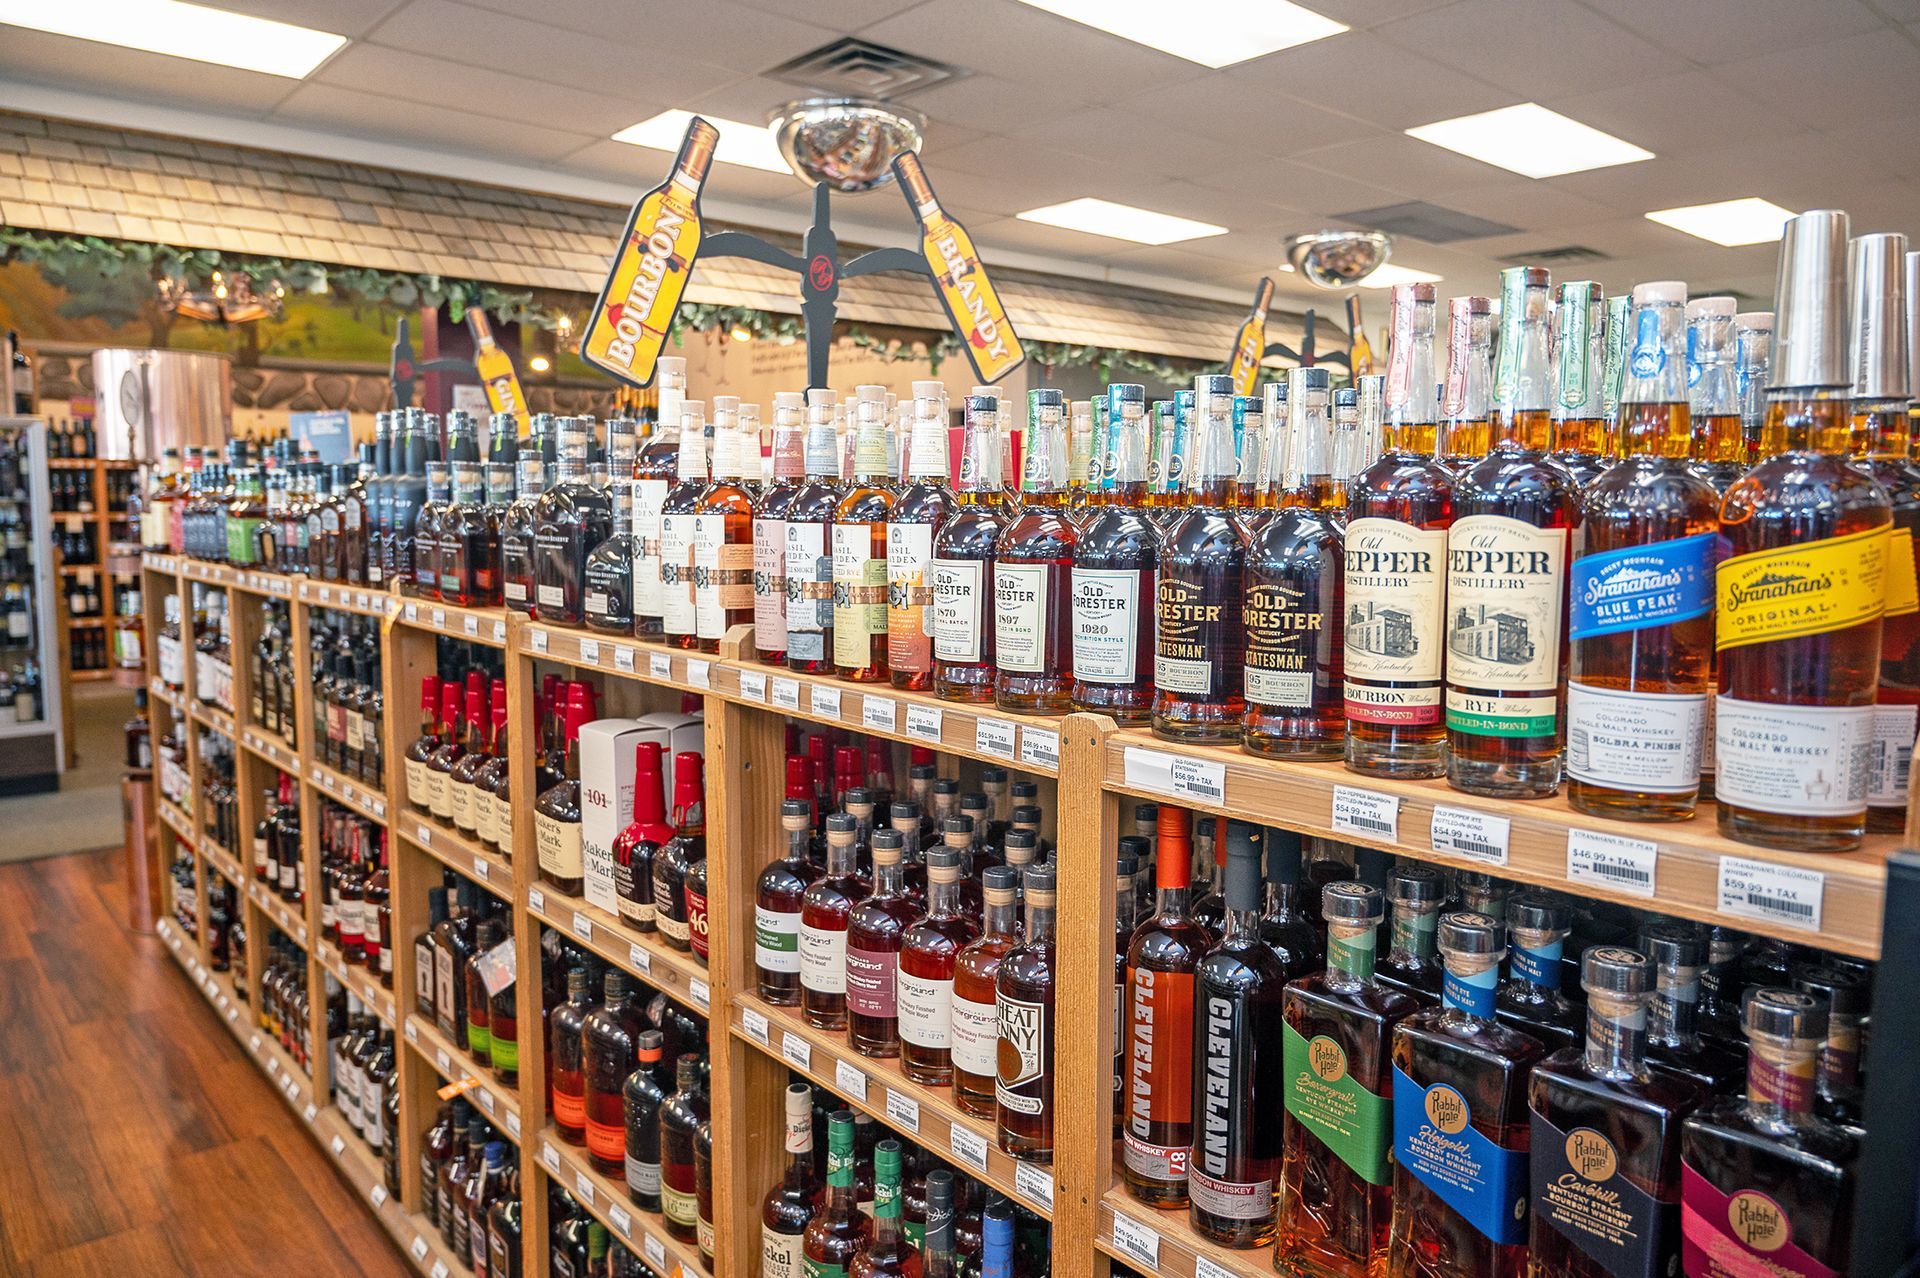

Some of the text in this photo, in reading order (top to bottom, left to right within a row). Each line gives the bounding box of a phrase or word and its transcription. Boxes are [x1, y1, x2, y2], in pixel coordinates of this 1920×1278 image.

[606, 206, 685, 369] BOURBON
[937, 235, 1009, 361] BRANDY
[1360, 536, 1384, 549] Old
[1471, 535, 1498, 548] Old
[1345, 550, 1433, 573] EPPER
[937, 574, 952, 584] OLD
[999, 578, 1015, 589] OLD
[1347, 576, 1409, 587] DISTILLERY
[1453, 576, 1526, 589] DISTILLERY
[1584, 568, 1681, 606] Stranahan's
[934, 584, 971, 596] RESTER
[996, 590, 1035, 602] RESTER
[1083, 585, 1103, 597] OLD
[1160, 586, 1187, 603] OLD
[1727, 573, 1832, 612] Stranahan's
[1254, 593, 1286, 610] OLD
[1596, 593, 1676, 617] BLUE PEAK
[937, 608, 956, 618] 1870
[998, 614, 1019, 625] 1897
[1157, 604, 1220, 622] RESTER
[1736, 602, 1830, 626] ORIGINAL
[1081, 624, 1108, 635] 1920
[1159, 642, 1202, 658] ATESMAN
[1245, 650, 1303, 669] STATESMAN
[1249, 673, 1261, 685] 95
[1347, 688, 1405, 704] BOURBON
[1466, 699, 1496, 713] RYE
[1596, 713, 1647, 725] COLORADO
[1603, 723, 1628, 733] MALT
[1631, 726, 1675, 736] WHISKEY
[1732, 728, 1788, 742] COLORADO
[999, 735, 1007, 743] TAX
[1043, 744, 1052, 752] TAX
[1738, 741, 1829, 756] MALT WHISKEY
[1174, 772, 1195, 782] $56.99
[1201, 777, 1213, 786] TAX
[587, 789, 608, 808] 101
[1335, 804, 1361, 815] $54.99
[1368, 810, 1382, 820] TAX
[540, 831, 562, 848] Mark
[1433, 825, 1462, 838] $54.99
[1472, 833, 1488, 843] TAX
[583, 839, 612, 860] Maker
[1572, 848, 1606, 862] $46.99
[1617, 857, 1635, 868] TAX
[1724, 878, 1762, 893] $59.99
[1776, 888, 1798, 900] TAX
[690, 909, 709, 935] 46
[998, 1000, 1036, 1028] HEAT
[1132, 967, 1154, 1137] CLEVELAND
[1315, 1042, 1340, 1064] Rabbit
[1320, 1061, 1338, 1077] Hole
[1205, 997, 1232, 1176] CLEVELAND
[1432, 1091, 1462, 1114] Rabbit
[1438, 1112, 1458, 1128] Hole
[1409, 1136, 1482, 1170] KENTUCKY STRAIGHT
[1574, 1134, 1609, 1159] Rabbit
[1134, 1141, 1186, 1172] WHISKEY 87
[1411, 1144, 1479, 1177] BOURBON WHISKEY
[1582, 1156, 1606, 1175] Hole
[1213, 1182, 1251, 1195] WHISKEY
[1547, 1183, 1633, 1222] KENTUCKY STRAIGHT
[1549, 1192, 1589, 1213] BOURBON
[1591, 1208, 1629, 1228] WHISKEY
[1738, 1198, 1779, 1227] Rabbit
[1747, 1224, 1775, 1243] Hole
[1139, 1239, 1149, 1249] TAX
